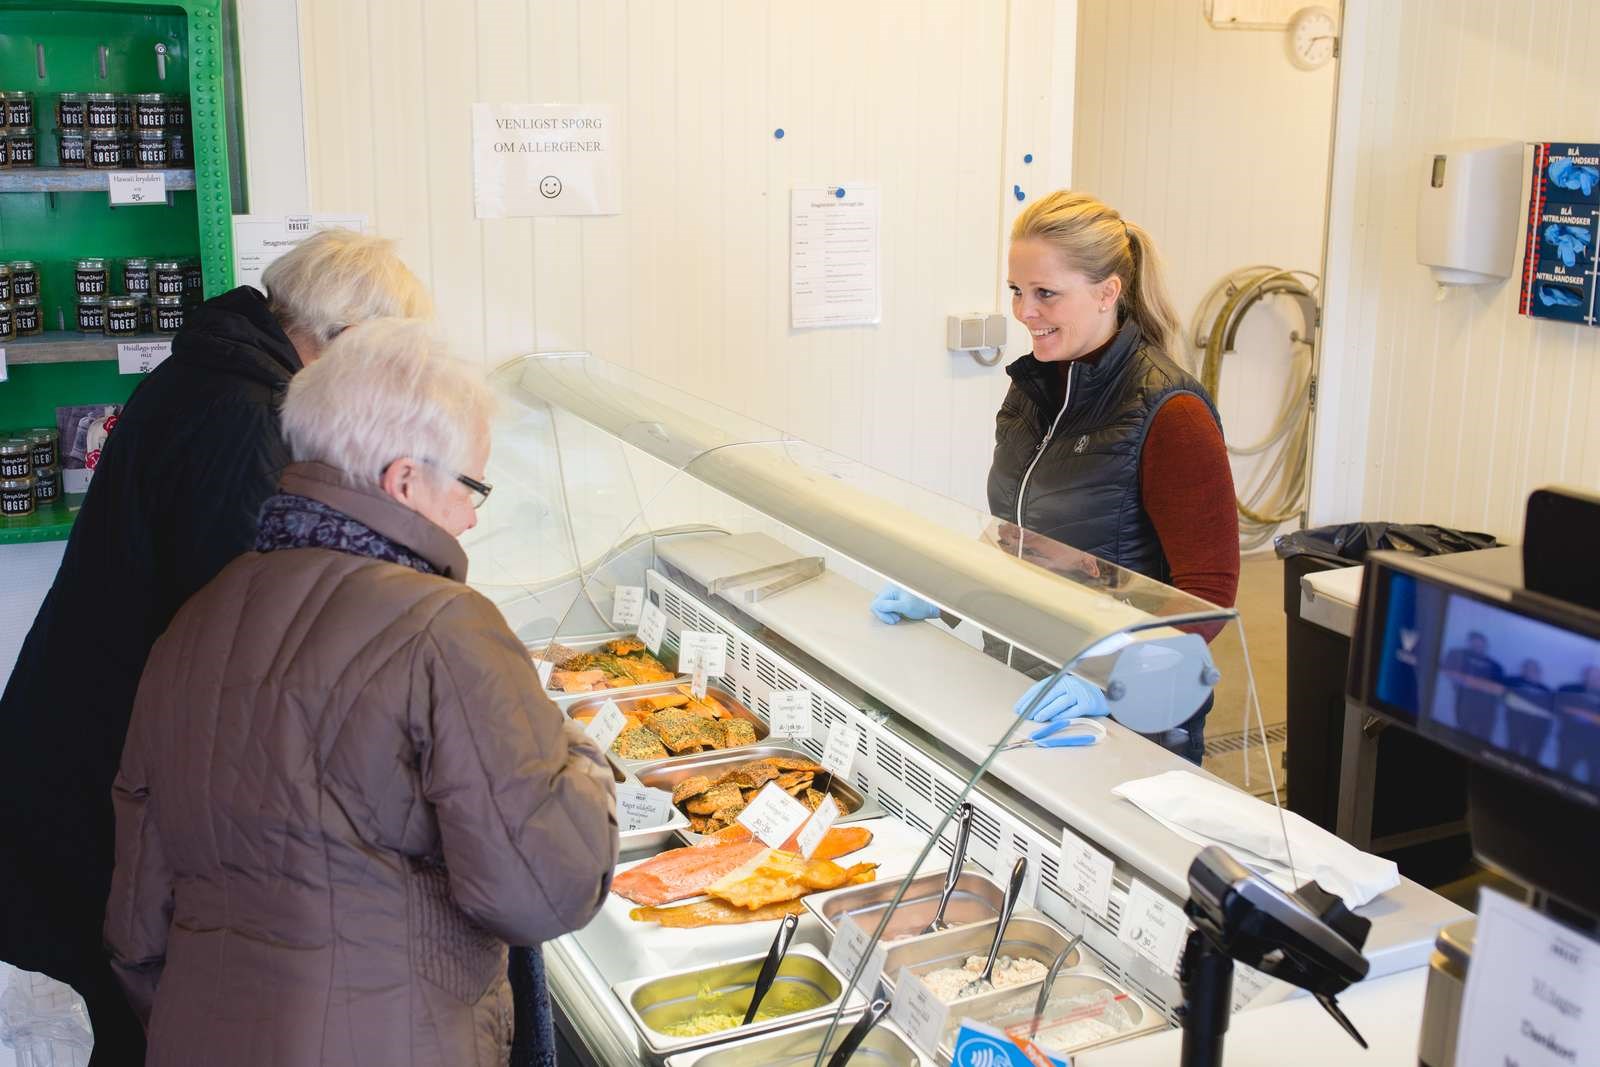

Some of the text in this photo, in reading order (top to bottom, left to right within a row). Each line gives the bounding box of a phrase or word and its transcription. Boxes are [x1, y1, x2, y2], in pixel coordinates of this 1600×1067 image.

[496, 118, 602, 129] VENLIGST SPØRG
[493, 142, 515, 152] OM
[1568, 146, 1580, 156] BLÅ
[1549, 155, 1599, 165] NITANDSKER
[1560, 206, 1572, 215] BLÅ
[1542, 214, 1591, 225] NITRILHANDSKER
[1555, 264, 1566, 274] BLÅ
[1536, 271, 1584, 285] NITRILHANDSKER
